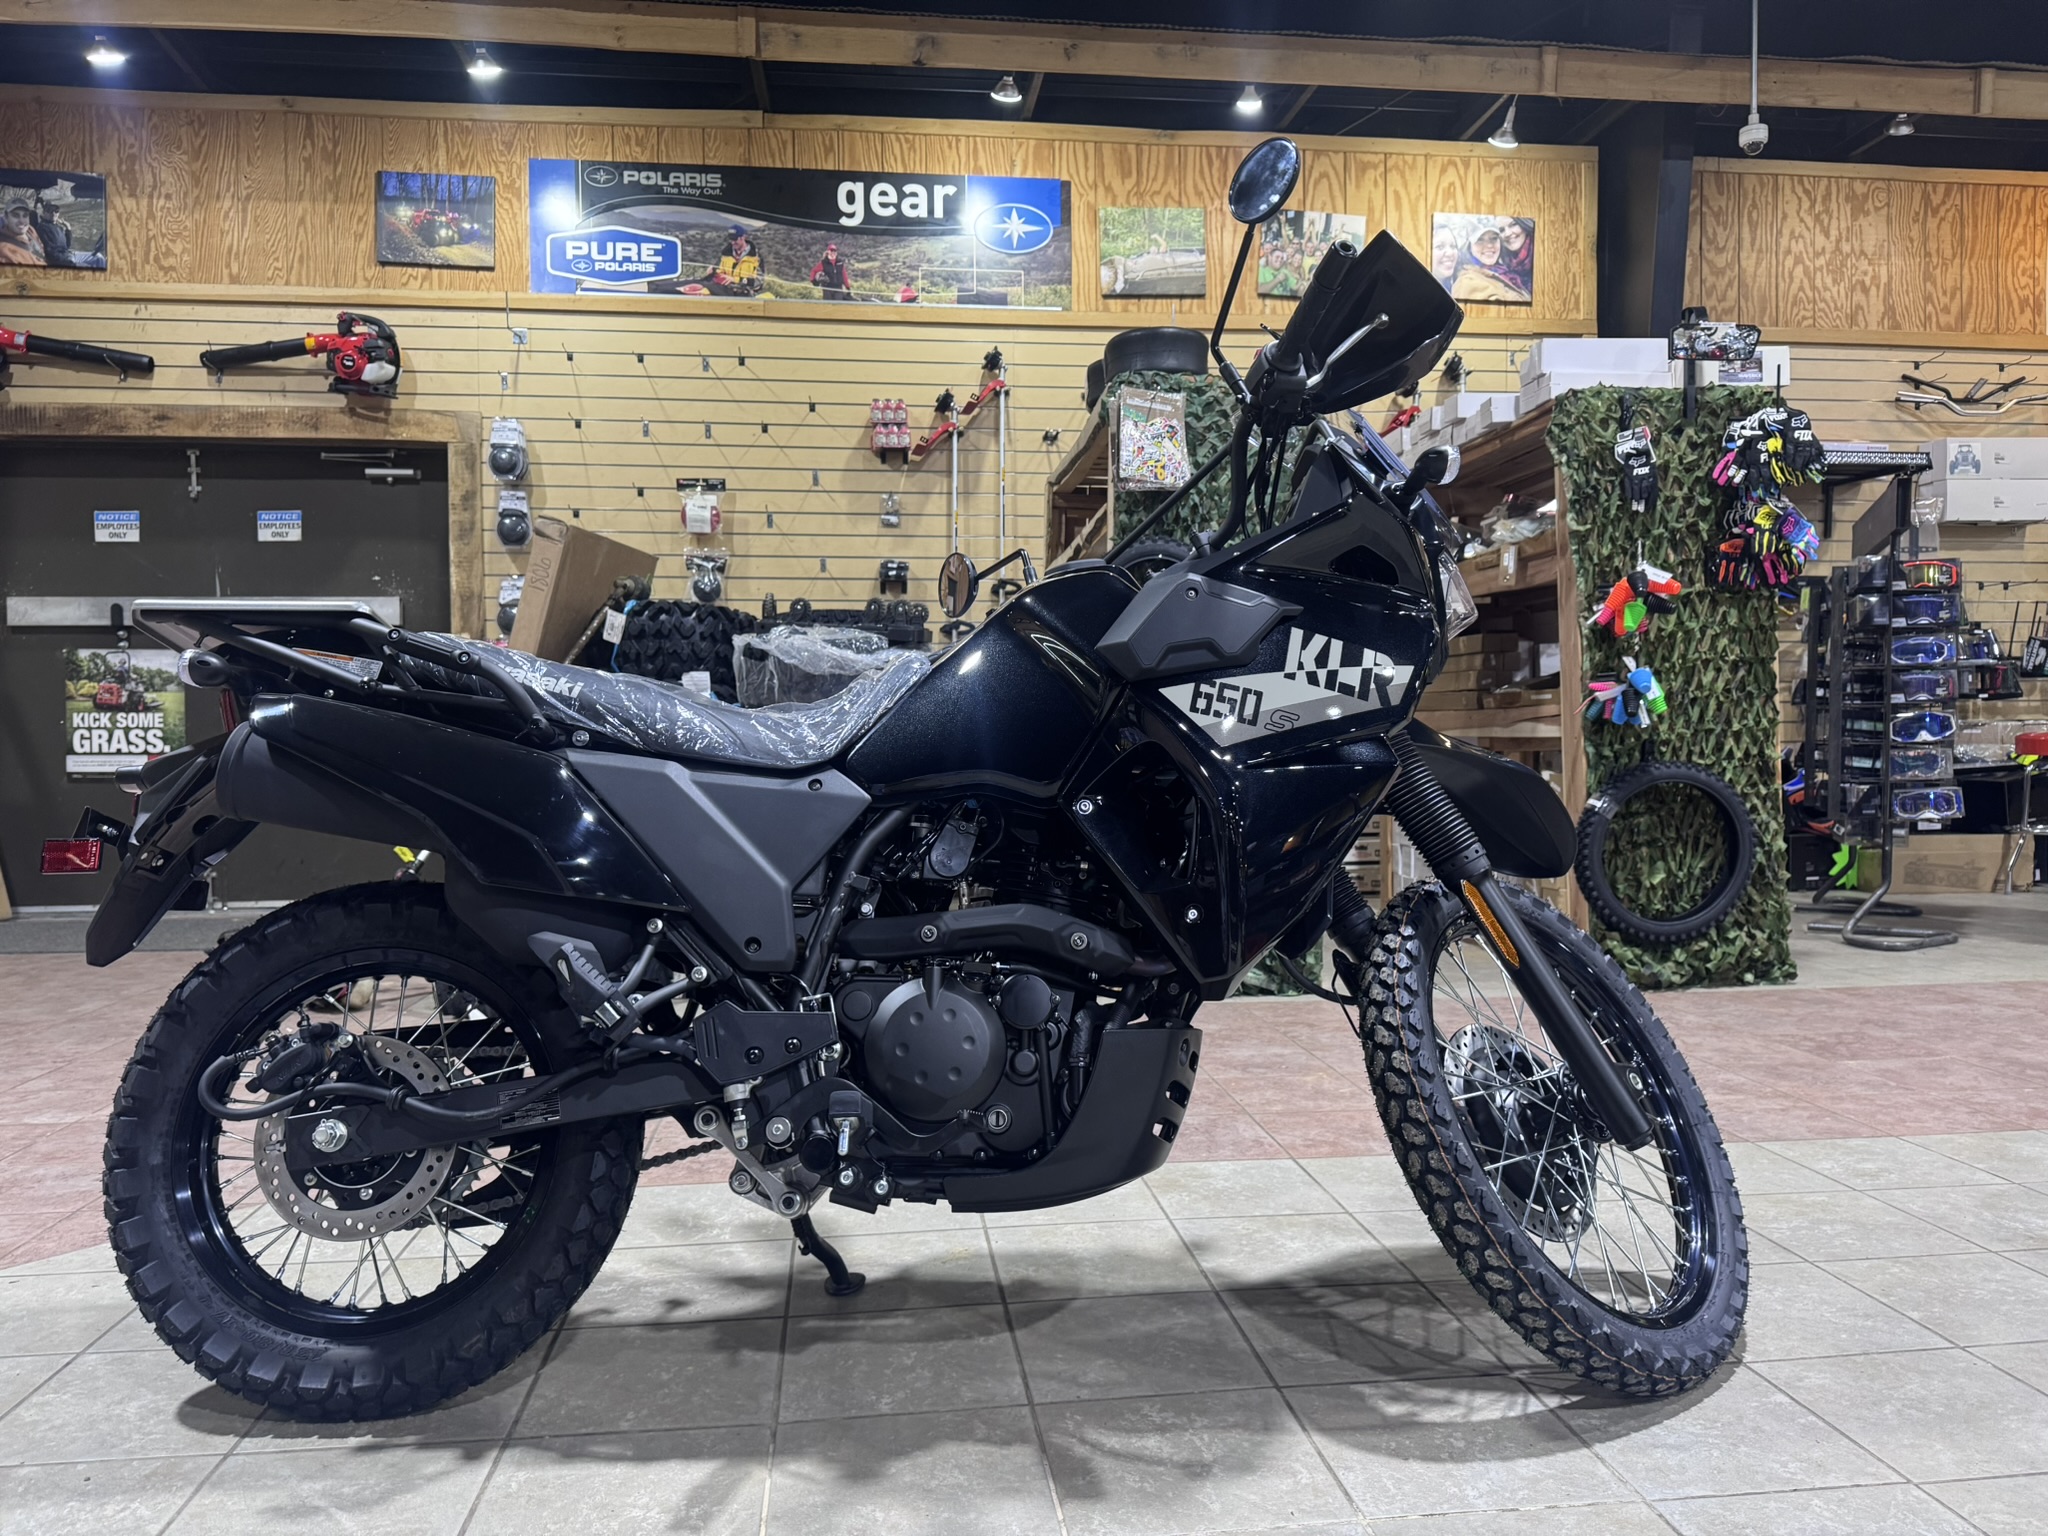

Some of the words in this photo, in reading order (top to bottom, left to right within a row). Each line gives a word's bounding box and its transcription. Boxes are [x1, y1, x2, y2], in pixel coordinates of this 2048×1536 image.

[623, 170, 723, 188] POLARIS
[662, 186, 679, 194] The
[680, 187, 701, 197] Way
[703, 187, 723, 196] Out.
[837, 180, 958, 227] gear
[565, 240, 664, 262] PURE
[594, 261, 656, 273] POLARIS
[1793, 429, 1813, 441] FOX
[1633, 465, 1651, 476] FOX
[98, 513, 137, 521] NOTICE
[96, 522, 140, 530] EMPLOYEES
[259, 522, 301, 530] EMPLOYEES
[108, 531, 127, 539] ONLY
[271, 530, 289, 538] ONLY
[1283, 626, 1396, 707] KLR
[498, 663, 585, 698] asaki
[1189, 680, 1263, 726] 650
[1264, 709, 1300, 732] S
[72, 712, 112, 728] KICK
[116, 712, 164, 728] SOME
[72, 728, 171, 754] GRASS.
